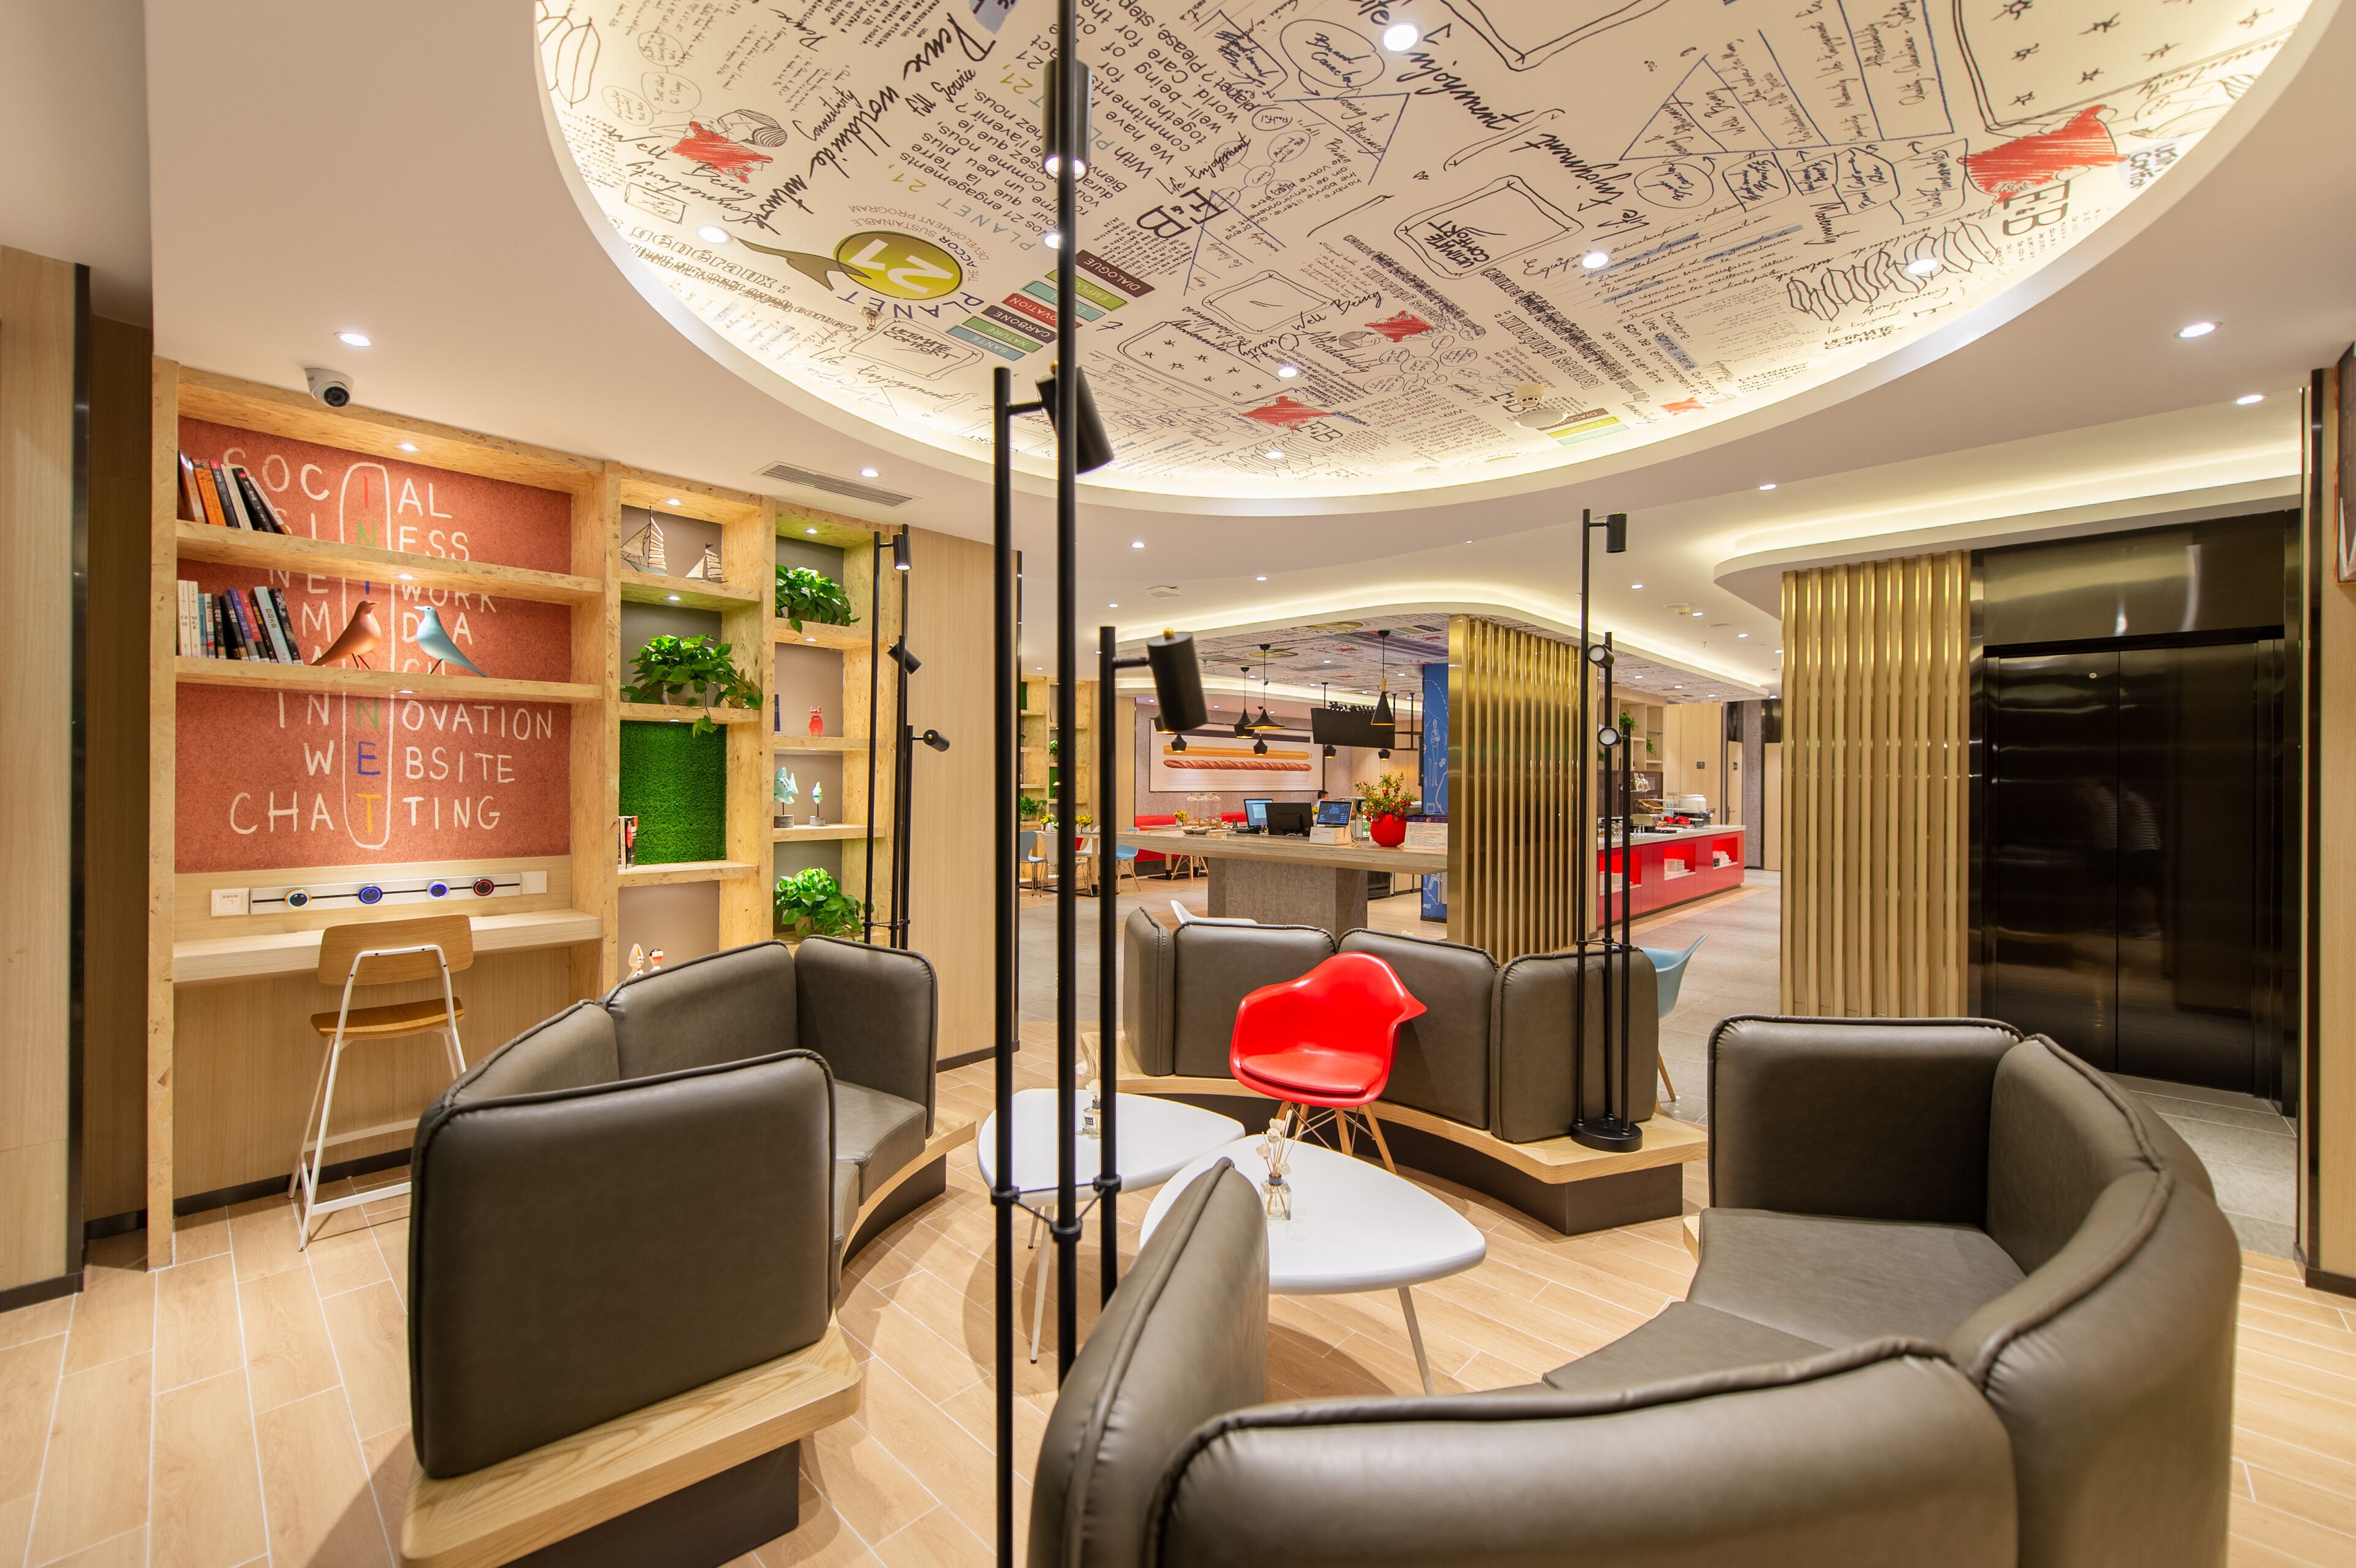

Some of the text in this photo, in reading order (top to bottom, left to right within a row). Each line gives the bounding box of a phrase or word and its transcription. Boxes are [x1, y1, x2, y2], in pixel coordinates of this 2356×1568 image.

[1100, 37, 1127, 61] of
[1115, 25, 1143, 47] for
[1158, 23, 1207, 71] Please,
[1148, 49, 1188, 83] Care
[975, 89, 1016, 120] nous.
[1016, 50, 1174, 164] We have 21
[1097, 63, 1206, 144] together for
[1195, 85, 1238, 123] world.
[958, 120, 1008, 150] que le
[970, 111, 1029, 148] l'avenir
[912, 144, 950, 171] Terre
[922, 133, 1024, 193] un peu plus
[937, 121, 1045, 191] Comme nous,
[1112, 144, 1154, 180] With
[1508, 134, 1632, 212] Enjoyment
[900, 153, 1002, 210] engagements
[964, 174, 982, 185] la
[1325, 179, 1361, 198] hambre
[742, 175, 814, 236] network
[994, 190, 1021, 206] que
[849, 206, 989, 260] DEVELOPMENT PROGRAM
[851, 217, 937, 237] SUSTAINABLE
[936, 193, 1036, 252] PLANET
[1003, 211, 1024, 223] 21
[937, 234, 977, 266] ACCOR
[1424, 234, 1474, 268] ULTIMATE
[1428, 221, 1490, 262] COMFORT
[846, 237, 954, 295] 21
[1083, 256, 1141, 292] DIALOGUE
[1072, 280, 1109, 302] EMPLO
[891, 327, 952, 355] ULTIMATE
[985, 325, 1028, 348] NATURE
[992, 310, 1051, 339] CARBONE
[883, 331, 960, 358] COMFORT
[279, 692, 552, 740] INNOVATION
[303, 740, 515, 784] WEBSITE
[229, 789, 501, 836] CHATTING
